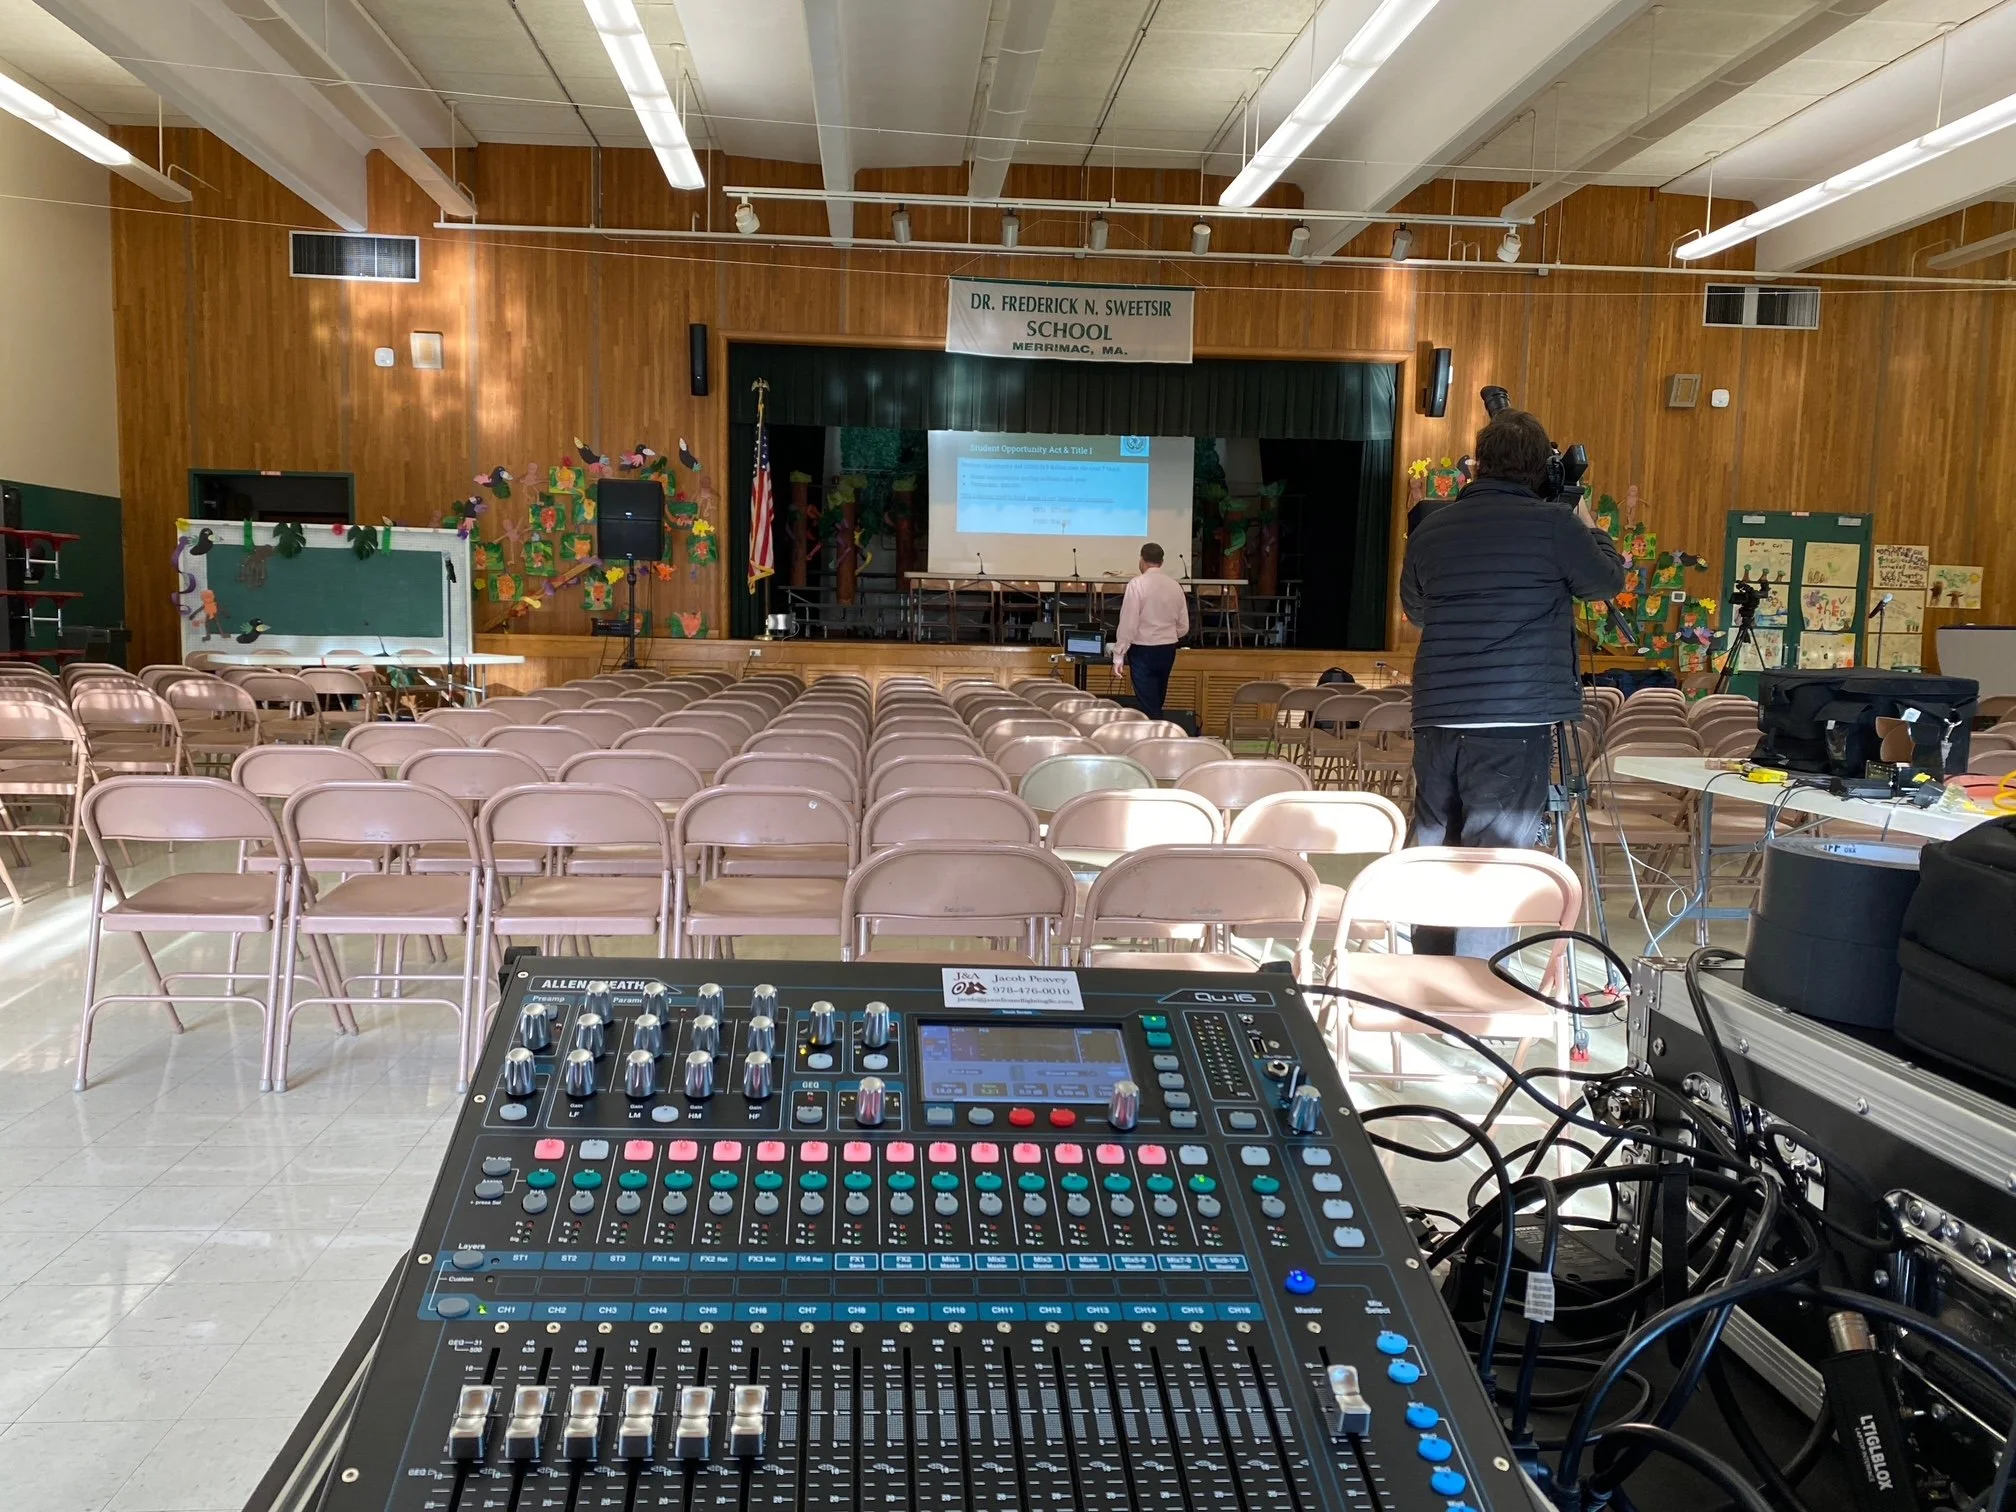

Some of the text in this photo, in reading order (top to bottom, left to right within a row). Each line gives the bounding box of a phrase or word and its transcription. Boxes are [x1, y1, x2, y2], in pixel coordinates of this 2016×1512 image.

[971, 293, 1171, 317] DR. FREDERICK N. SWEETSIR
[1027, 320, 1112, 341] SCHOOL
[1012, 342, 1128, 355] MERRIMAC, MA.
[970, 444, 999, 453] Student
[1001, 445, 1047, 455] Opportunity
[1049, 446, 1062, 454] Act
[1063, 446, 1069, 454] &
[1070, 446, 1087, 454] Title
[954, 972, 980, 981] J&A
[992, 974, 1067, 984] Jacob Peavey
[993, 986, 1070, 995] 978-476-0010
[533, 995, 566, 1003] Preamp
[1194, 992, 1257, 1003] Qu-16
[802, 1081, 819, 1089] GEQ
[652, 1255, 667, 1263] FX1
[700, 1255, 715, 1263] FX2
[748, 1255, 763, 1263] FX3
[795, 1255, 811, 1263] FX4
[498, 1306, 515, 1314] CH1
[548, 1306, 566, 1314] CH2
[598, 1306, 617, 1314] CH3
[649, 1306, 667, 1314] CH4
[699, 1306, 718, 1314] CH5
[749, 1306, 767, 1314] CH6
[798, 1306, 817, 1314] CH7
[1860, 1415, 1893, 1491] LTIGLBLOX
